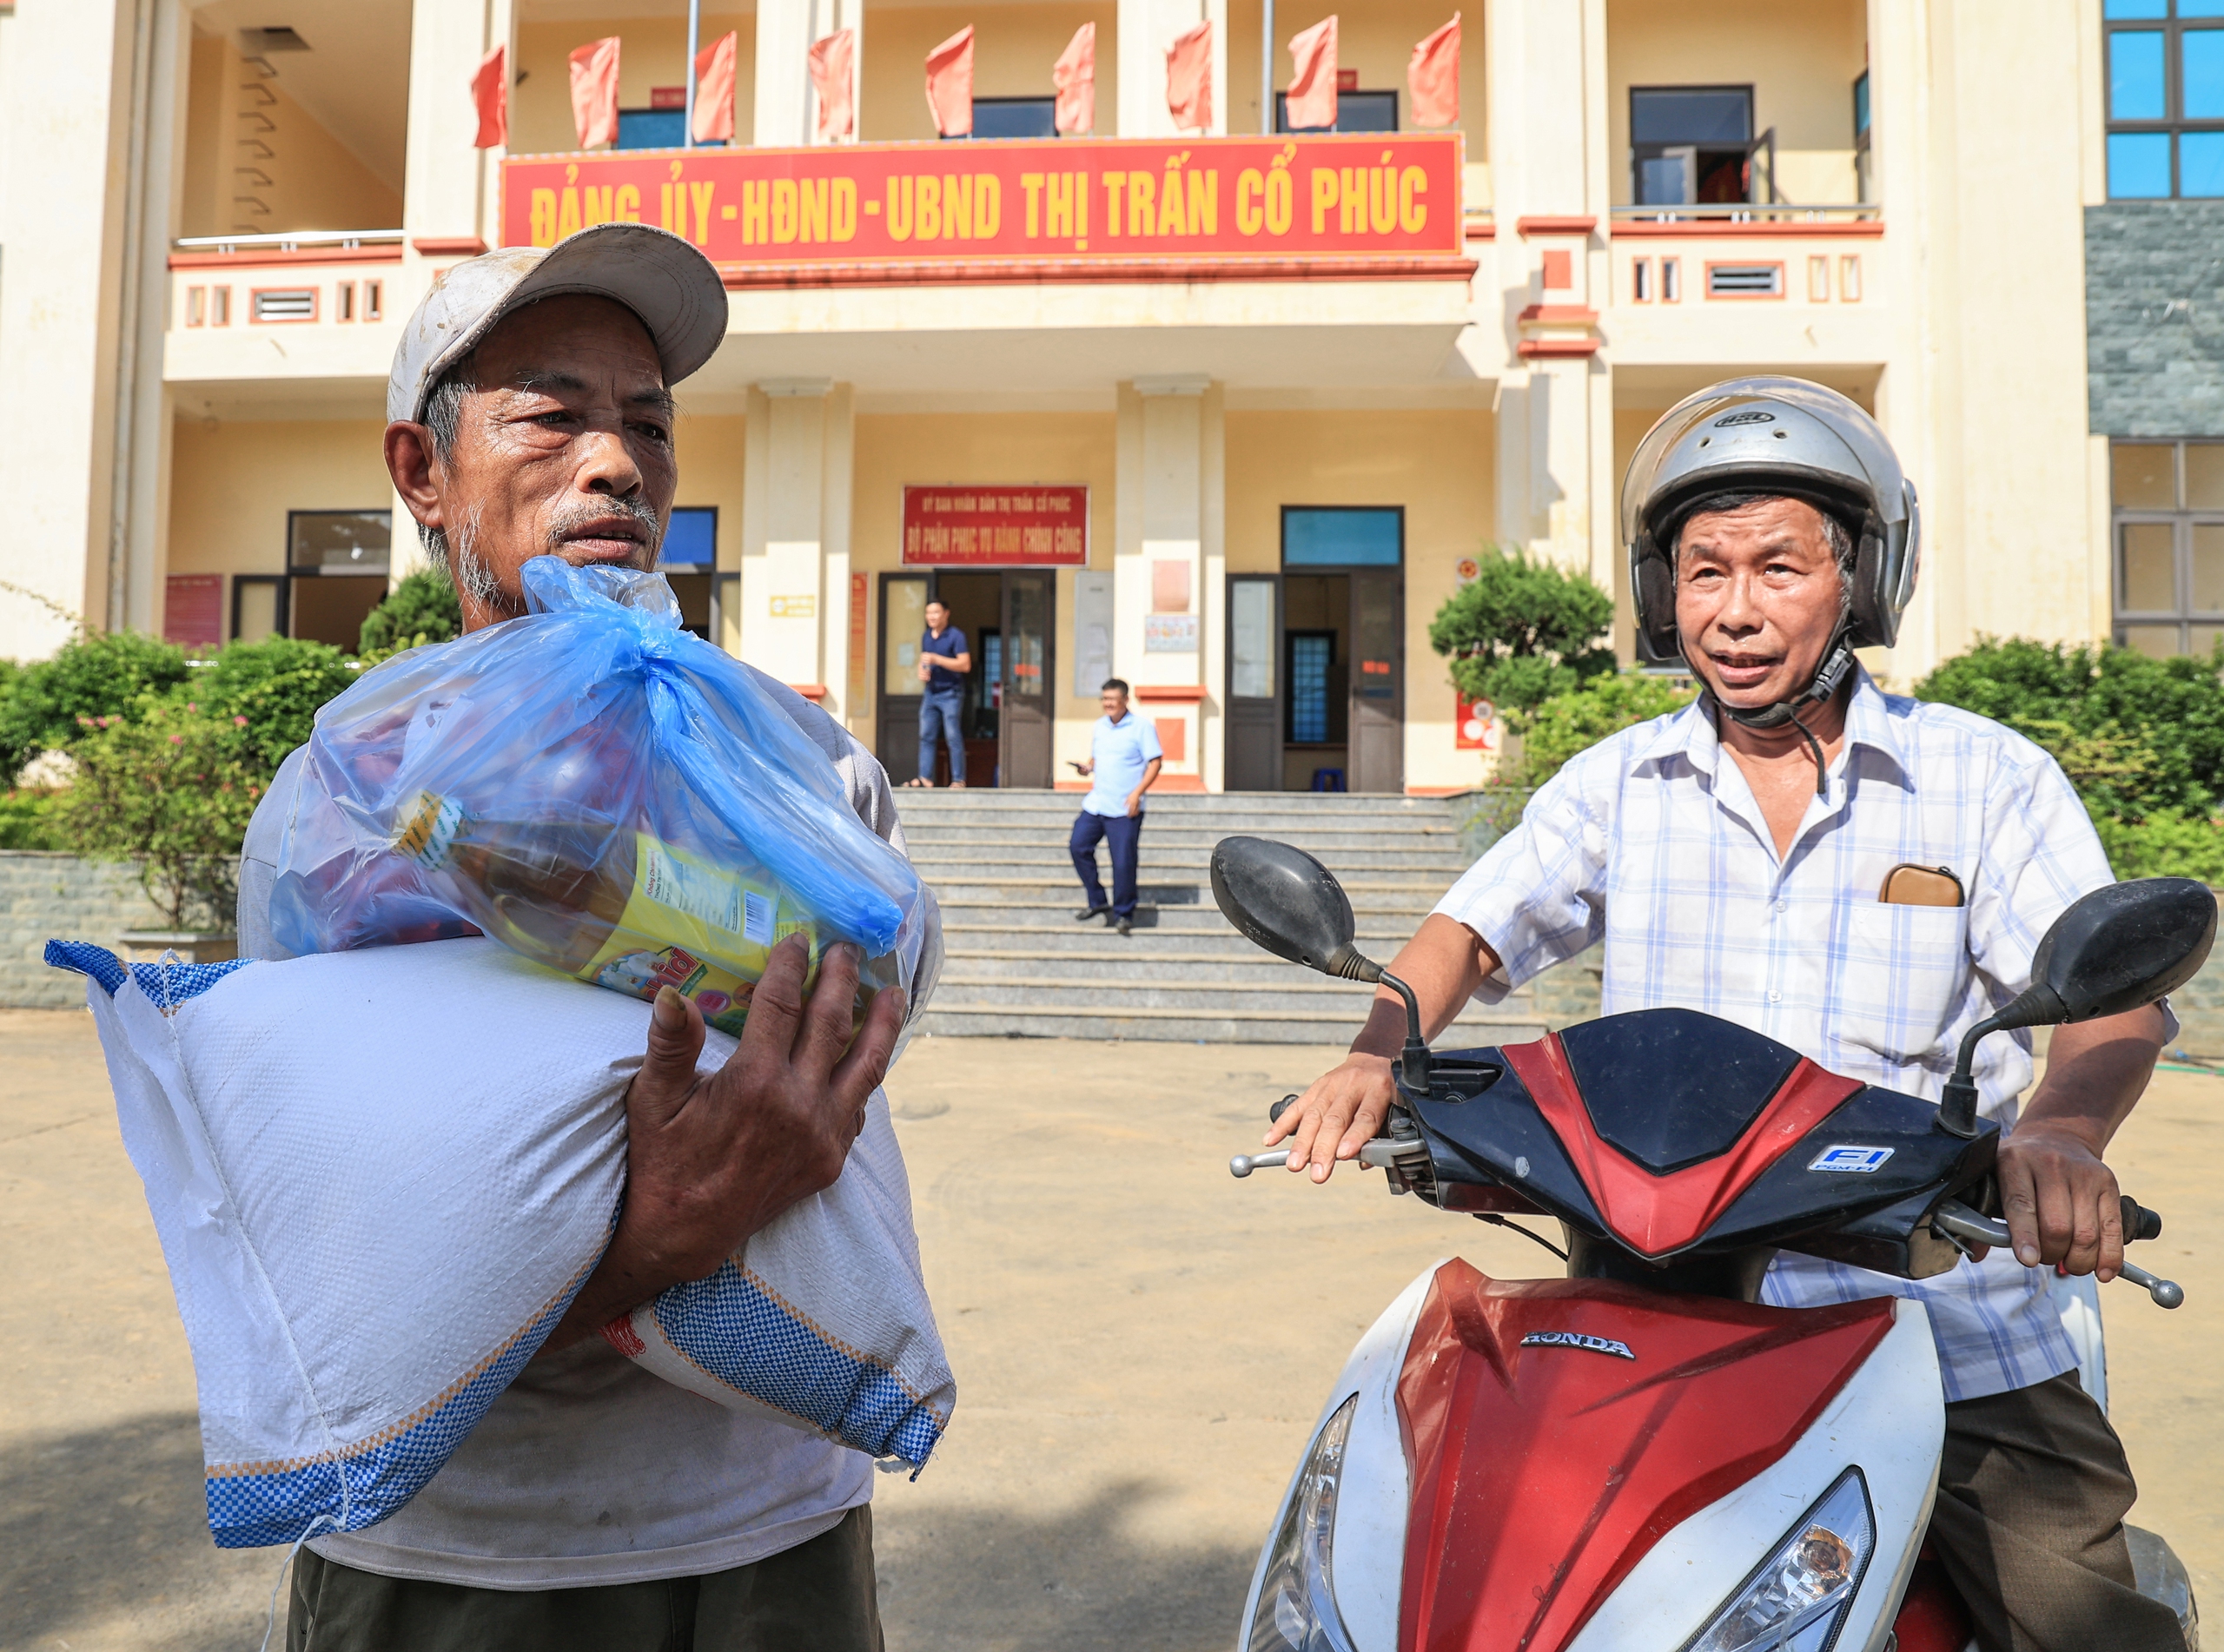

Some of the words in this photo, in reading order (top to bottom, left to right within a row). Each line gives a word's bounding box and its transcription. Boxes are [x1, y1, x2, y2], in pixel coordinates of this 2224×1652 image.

[529, 163, 641, 247] ĐẢNG
[1021, 171, 1089, 252] THỊ
[1102, 150, 1219, 237] TRẤN
[1235, 142, 1298, 236] CỔ
[1311, 149, 1428, 235] PHÚC
[1823, 1149, 1885, 1164] FI
[1520, 1332, 1635, 1359] HONDA
